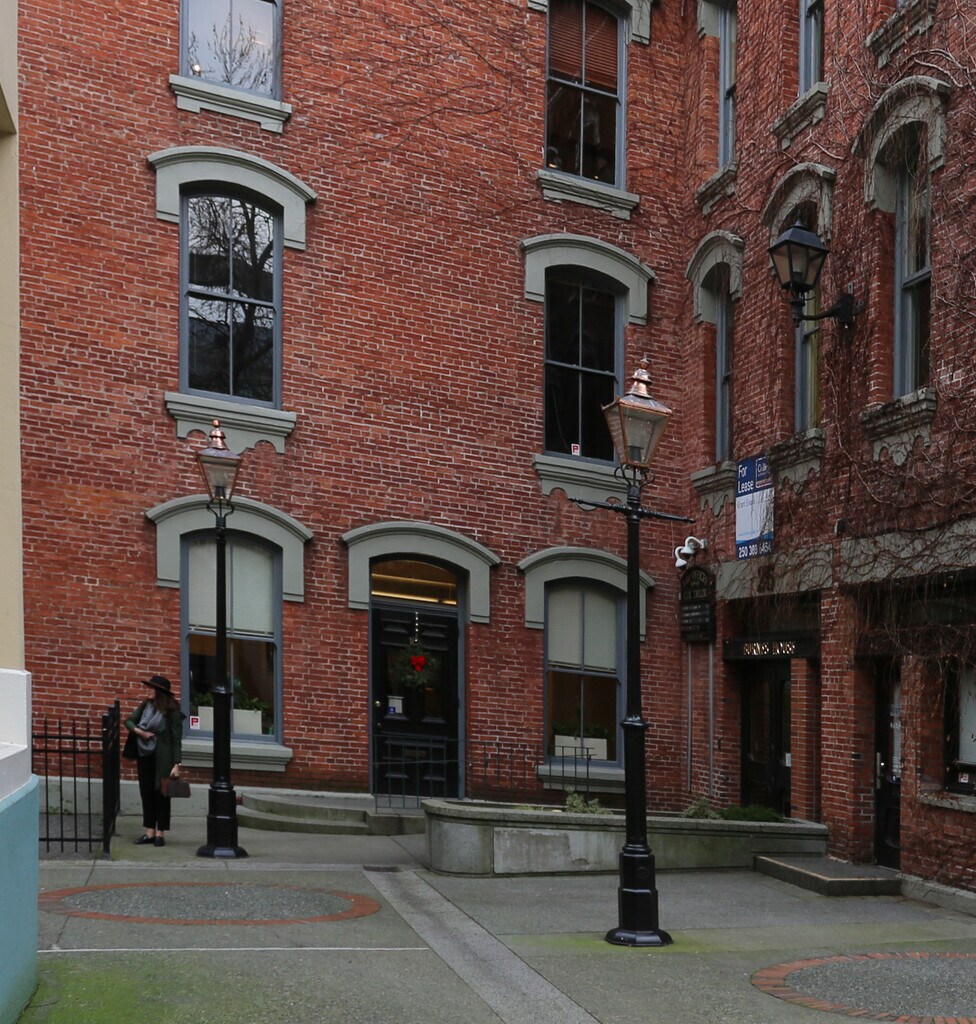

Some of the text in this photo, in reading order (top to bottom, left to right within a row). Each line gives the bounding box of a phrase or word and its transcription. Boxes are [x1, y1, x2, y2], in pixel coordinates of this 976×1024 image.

[738, 464, 748, 478] For
[737, 480, 754, 494] Lease
[738, 546, 748, 558] 250
